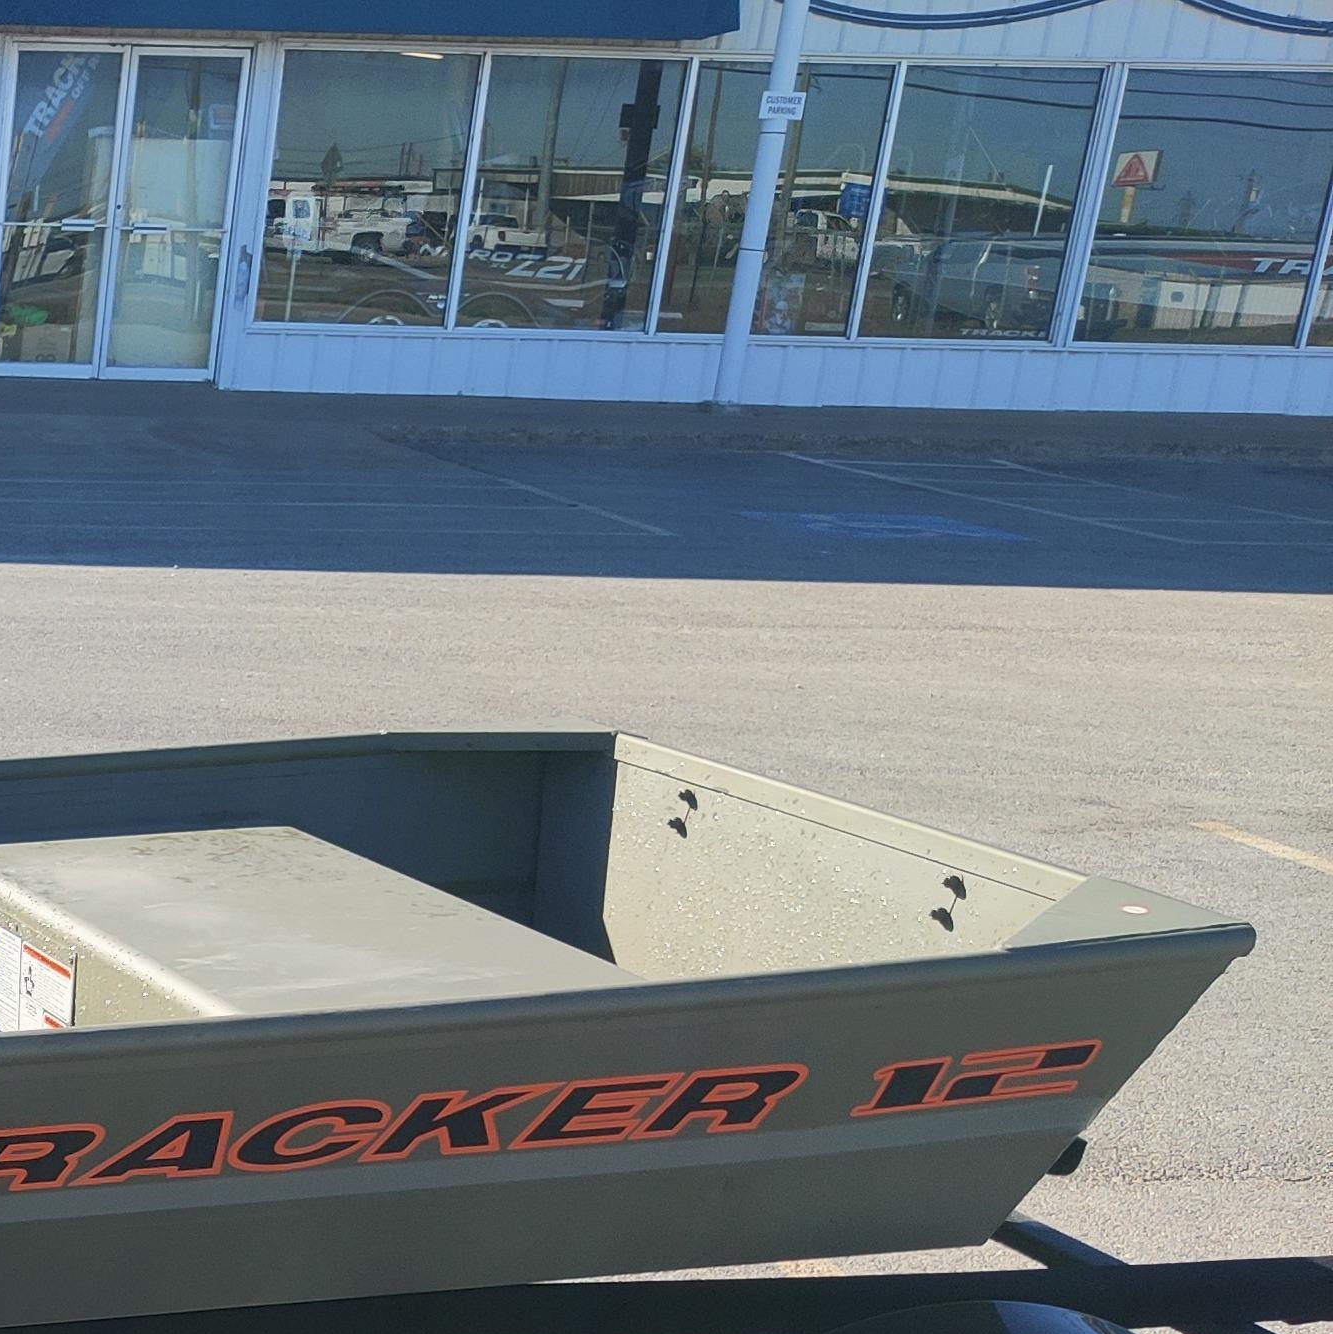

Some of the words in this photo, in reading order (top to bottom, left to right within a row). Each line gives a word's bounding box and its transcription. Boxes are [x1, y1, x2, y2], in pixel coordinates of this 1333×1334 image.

[766, 95, 803, 105] CUSTOMER
[767, 106, 797, 116] PARKING
[849, 1038, 1103, 1118] 12
